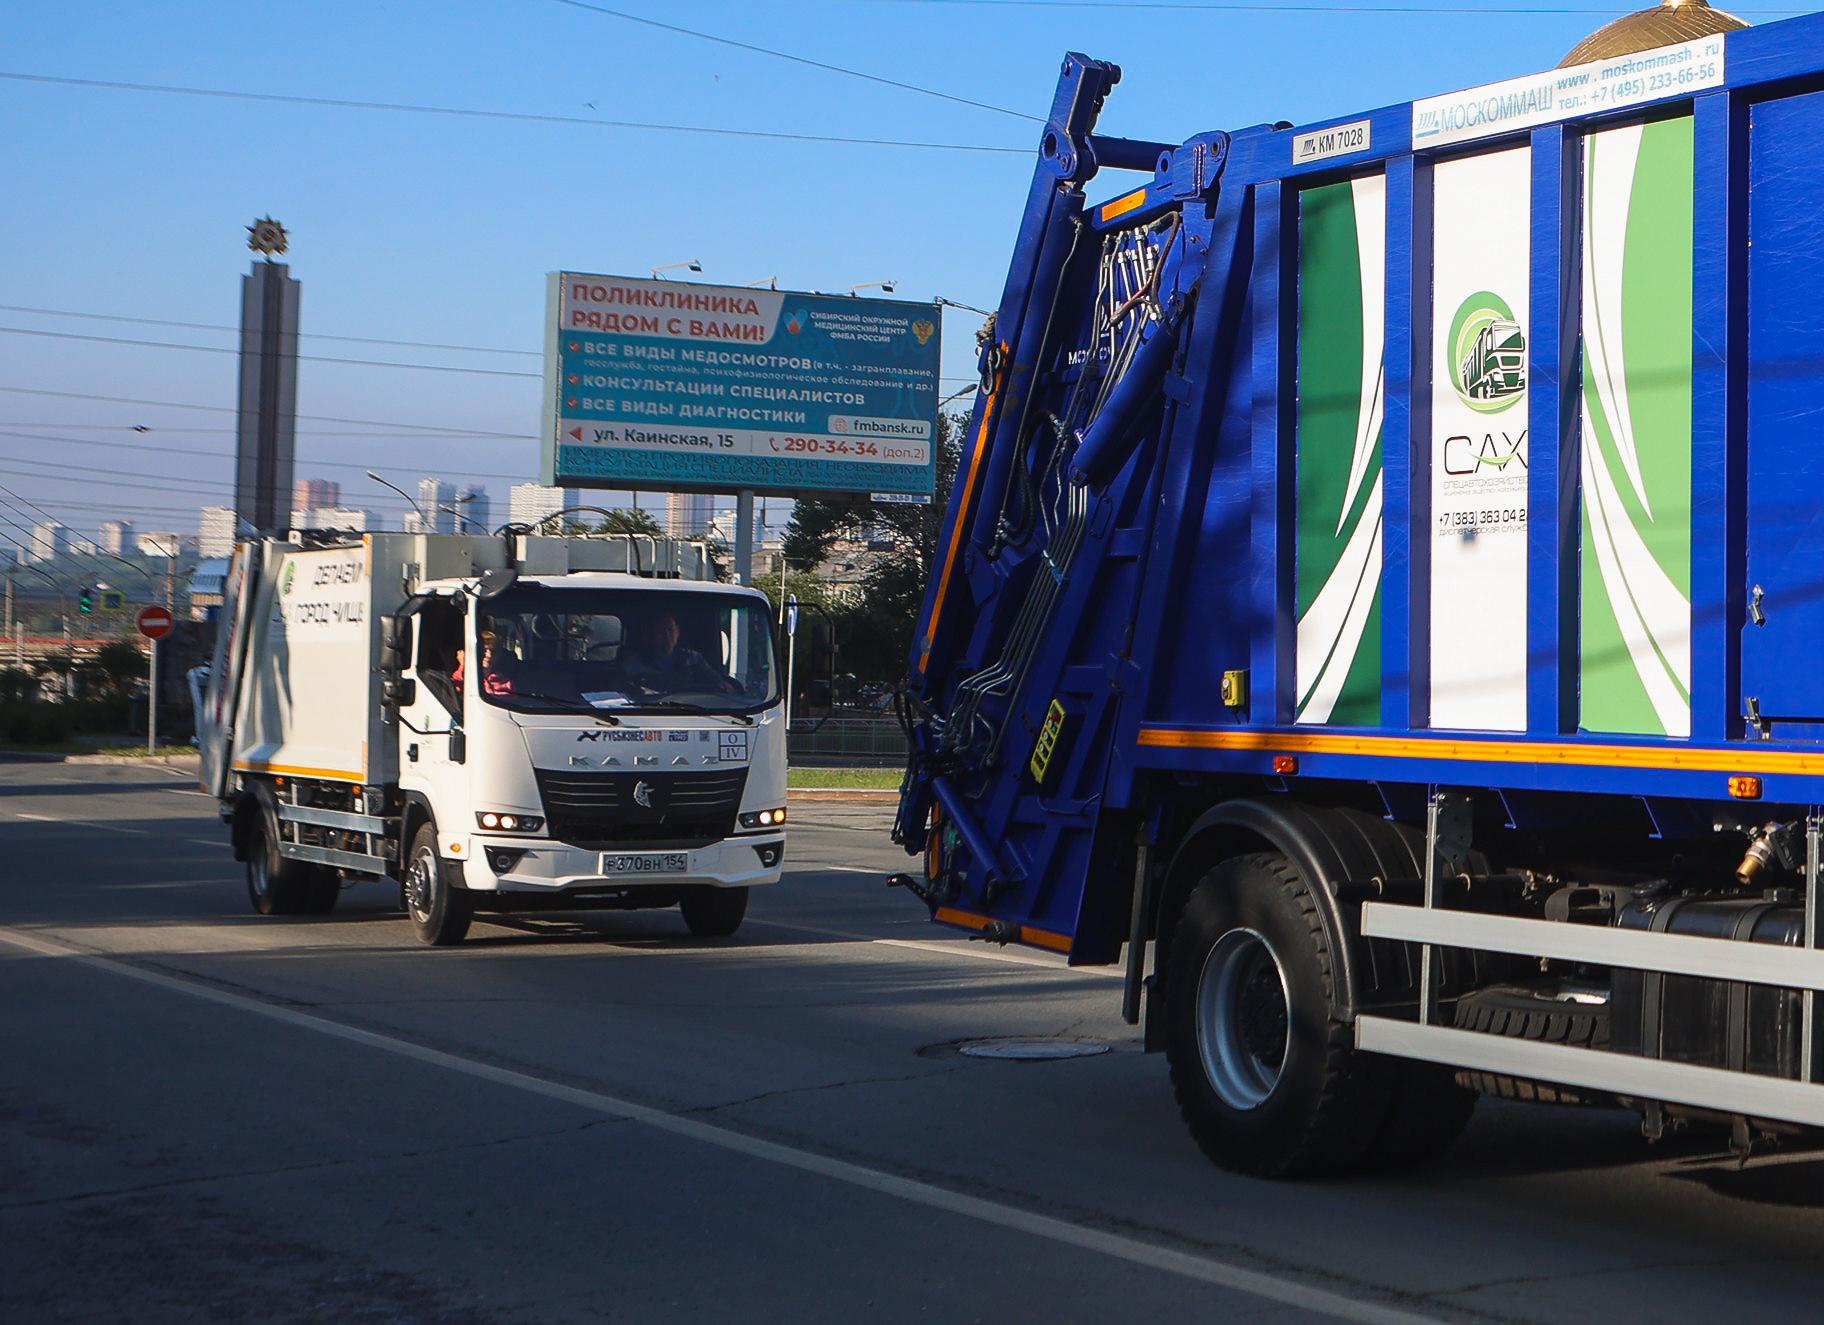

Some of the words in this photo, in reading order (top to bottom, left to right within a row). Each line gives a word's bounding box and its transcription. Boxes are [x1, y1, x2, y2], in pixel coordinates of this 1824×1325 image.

[1557, 72, 1590, 90] www
[1602, 48, 1692, 80] moskommash
[1705, 43, 1719, 56] ru
[1558, 94, 1587, 110] тел.:
[1591, 87, 1607, 102] +7
[1611, 78, 1645, 103] (495)
[1649, 63, 1715, 92] 233-66-56
[1441, 85, 1553, 133] МОСКОММАШ
[1338, 128, 1363, 149] 7028
[572, 283, 759, 316] ПОЛИКЛИНИКА
[572, 310, 659, 333] РЯДОМ
[667, 318, 682, 335] С
[689, 319, 765, 342] ВАМИ!
[810, 311, 860, 322] СИБИРСКИЙ
[862, 315, 909, 326] ОКРУЖНОЙ
[814, 321, 878, 333] МЕДИЦИНСКИЙ
[880, 326, 906, 335] ЦЕНТР
[830, 332, 855, 340] ФМБА
[857, 334, 890, 343] РОССИИ
[584, 342, 617, 355] ВСЕ
[623, 344, 675, 361] ВИДЫ
[681, 350, 811, 370] МЕДОСМОТРОВ
[583, 375, 724, 397] КОНСУЛЬТАЦИИ
[730, 385, 865, 405] СПЕЦИАЛИСТОВ
[832, 376, 903, 389] обследование
[582, 398, 616, 411] ВСЕ
[622, 401, 673, 416] ВИДЫ
[679, 404, 806, 423] ДИАГНОСТИКИ
[854, 420, 924, 434] fmbansk.ru
[593, 428, 619, 443] ул.
[624, 428, 713, 448] Каинская,
[717, 434, 734, 448] 15
[784, 437, 878, 456] 290-34-34
[883, 447, 924, 460] (доп.2)
[1440, 513, 1450, 526] +7
[1452, 511, 1477, 527] (383)
[1480, 510, 1500, 524] 363
[1502, 510, 1516, 523] 04
[1519, 509, 1528, 522] 2
[726, 747, 740, 758] IV
[664, 855, 684, 866] 154
